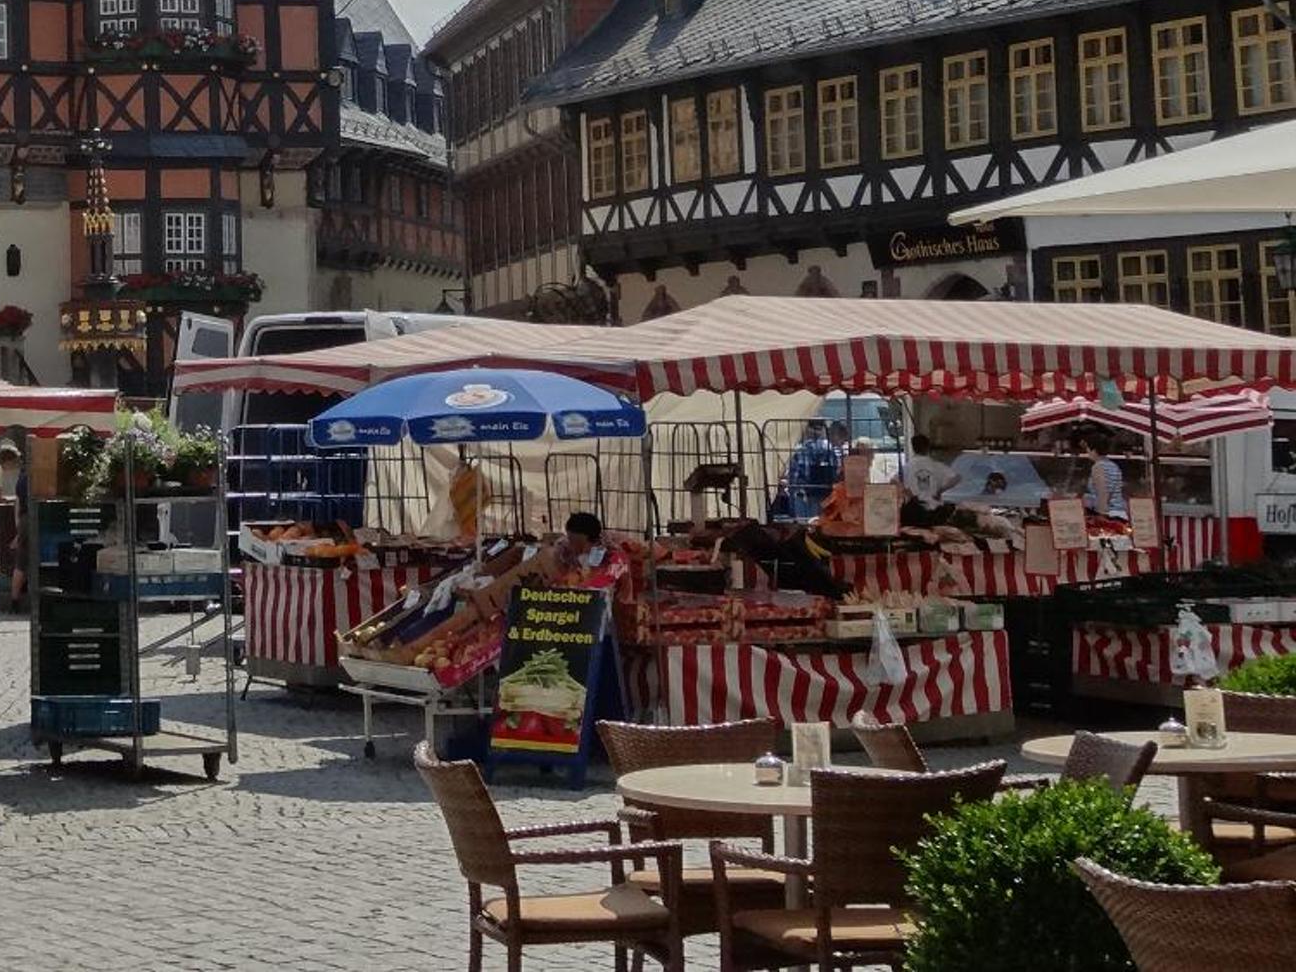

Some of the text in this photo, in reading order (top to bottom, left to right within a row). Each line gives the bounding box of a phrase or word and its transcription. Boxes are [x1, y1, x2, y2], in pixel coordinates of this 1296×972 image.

[967, 235, 1000, 253] Haus
[520, 588, 592, 604] Deutscher
[527, 608, 580, 625] Spargel
[508, 626, 593, 644] & Erdbeeren
